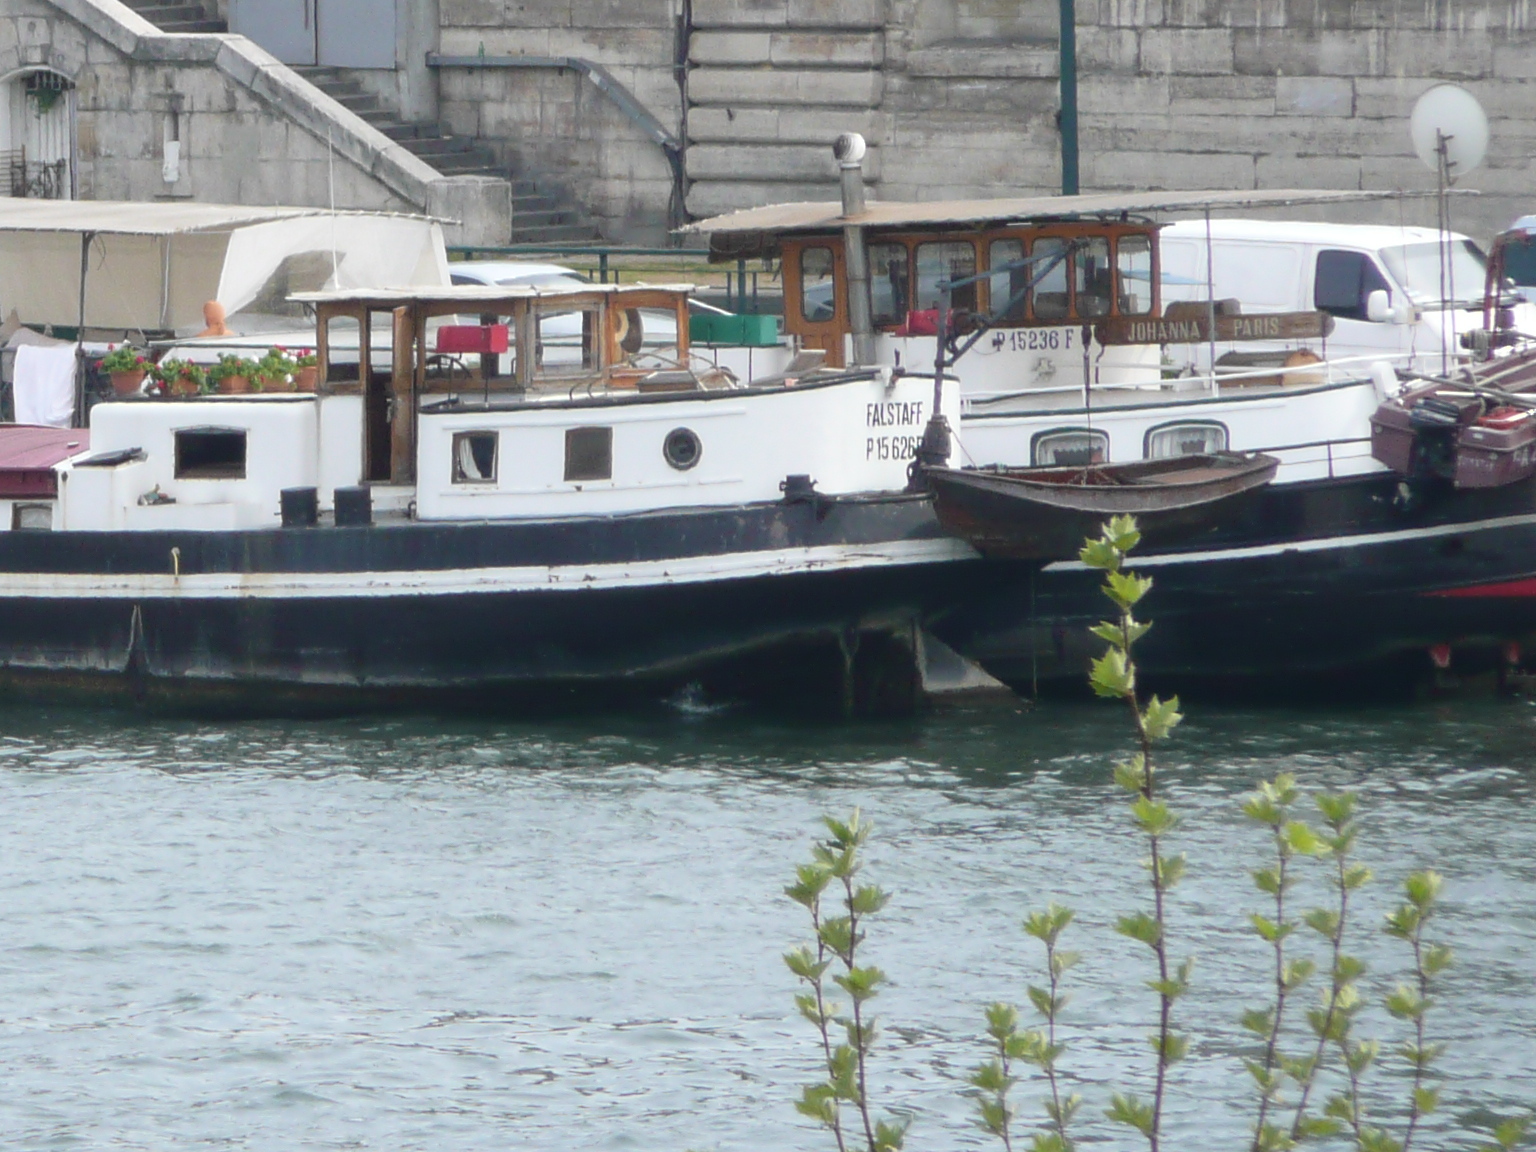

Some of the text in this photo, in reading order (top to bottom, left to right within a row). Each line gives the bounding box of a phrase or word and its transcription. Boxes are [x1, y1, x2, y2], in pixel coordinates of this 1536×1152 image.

[1010, 329, 1059, 351] 15236
[1127, 316, 1281, 342] JOHANNA PARIS
[866, 400, 923, 427] FALSTAFF
